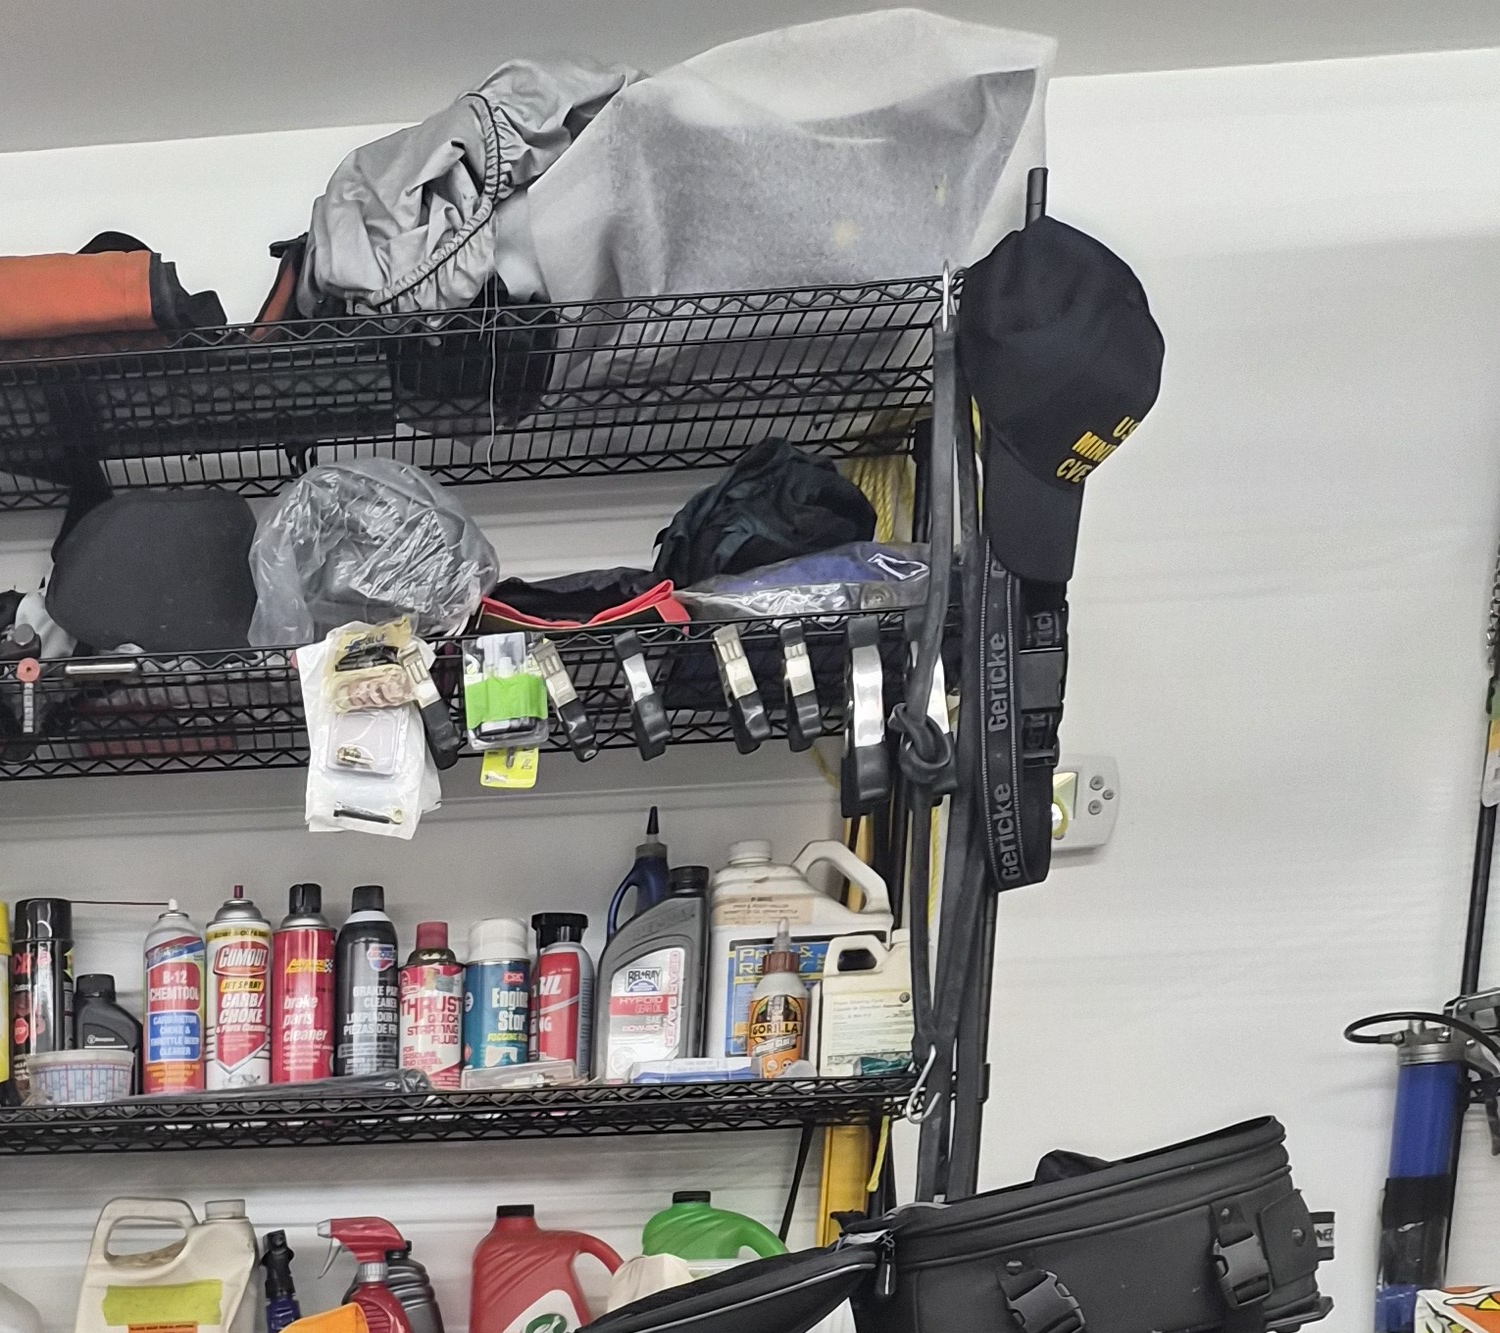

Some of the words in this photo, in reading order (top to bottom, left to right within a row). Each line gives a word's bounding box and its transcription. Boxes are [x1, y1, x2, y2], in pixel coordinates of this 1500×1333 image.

[987, 632, 1010, 734] Gericke
[993, 782, 1021, 881] Gericke
[219, 947, 267, 968] GUMOUT
[162, 970, 188, 984] B-12
[149, 986, 199, 1001] CHEMTOOL
[353, 985, 385, 998] BRAKE
[221, 993, 265, 1008] CARB/
[284, 995, 318, 1010] brake
[619, 996, 664, 1005] HYPOID
[219, 1008, 264, 1024] CHOKE
[283, 1012, 315, 1028] parts
[428, 1013, 459, 1024] QUICK
[283, 1029, 328, 1042] cleaner
[407, 1024, 459, 1036] STARTING
[752, 1022, 799, 1035] GORILLA
[431, 1035, 459, 1045] FLUID
